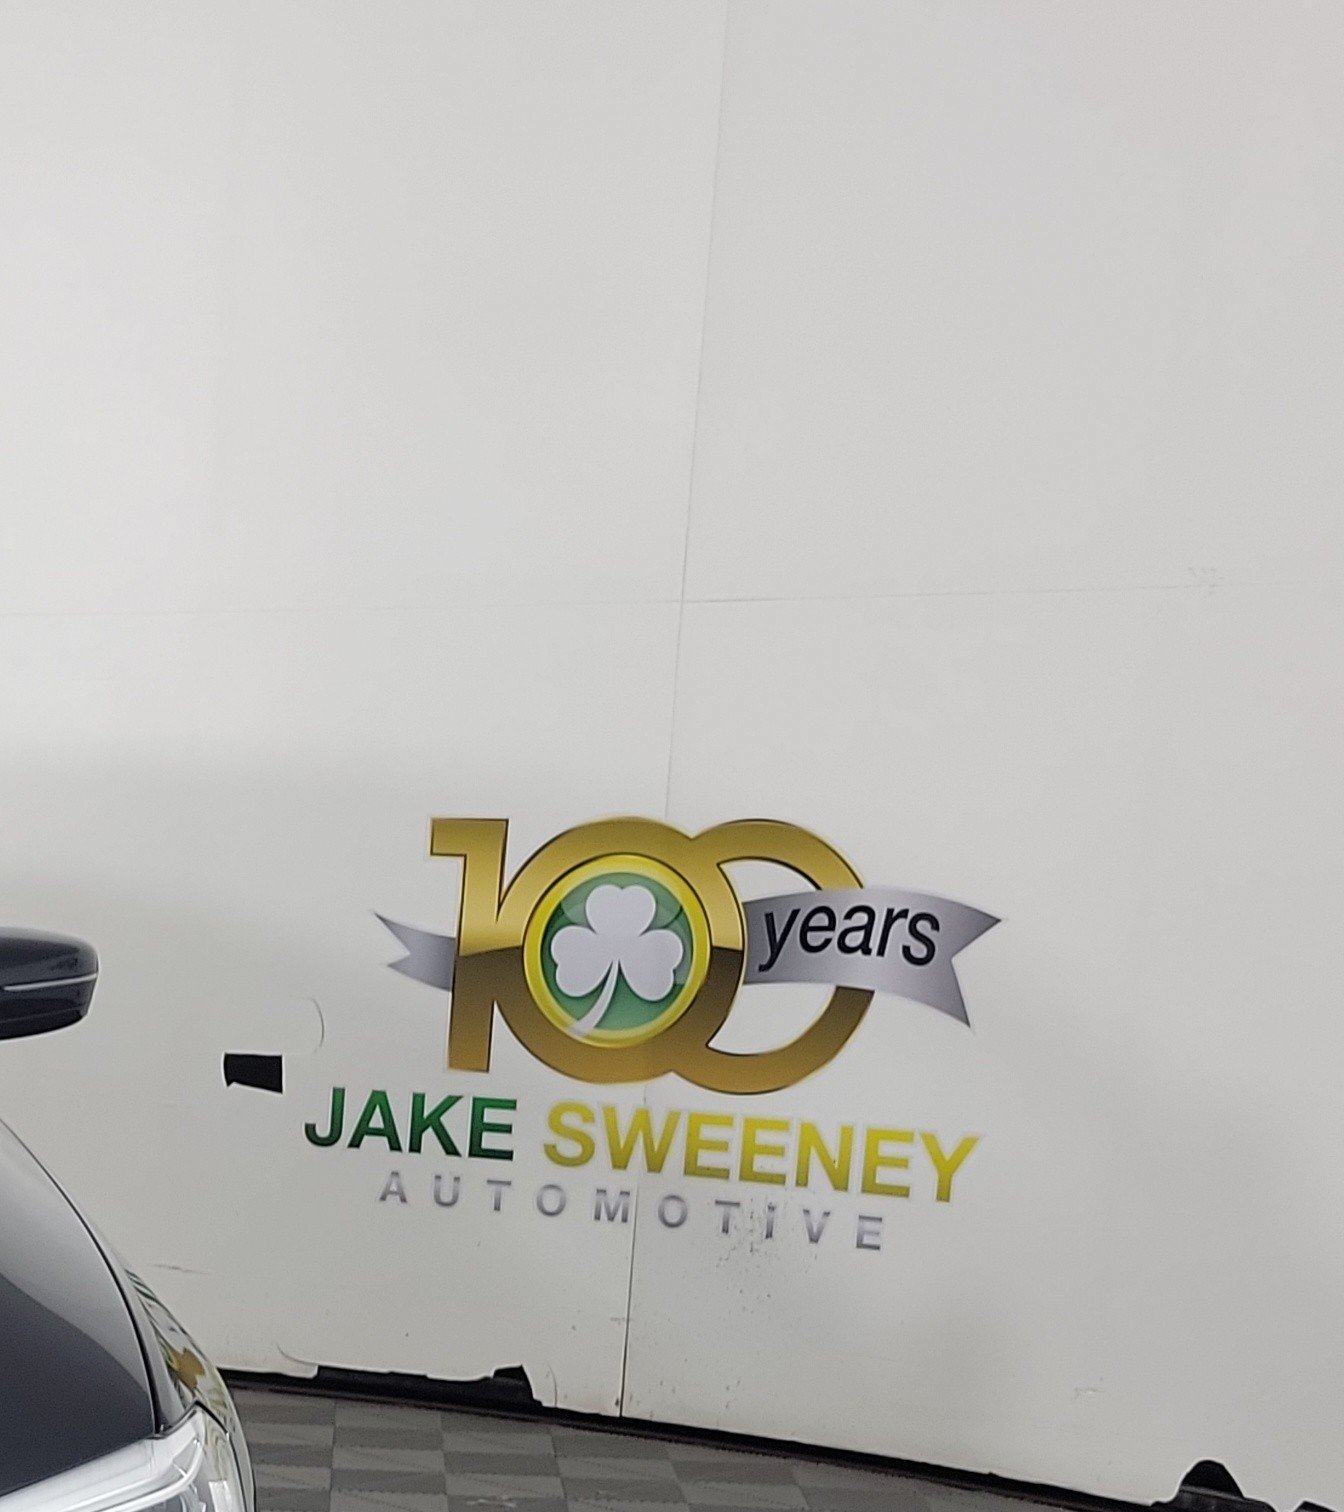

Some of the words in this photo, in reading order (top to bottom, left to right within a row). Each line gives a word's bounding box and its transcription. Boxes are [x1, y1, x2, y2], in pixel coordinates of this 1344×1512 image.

[430, 817, 875, 1095] 100
[756, 903, 942, 972] years
[304, 1086, 518, 1162] JAKE
[543, 1101, 980, 1203] SWEENEY
[378, 1169, 884, 1252] AUTOMOTIVE
